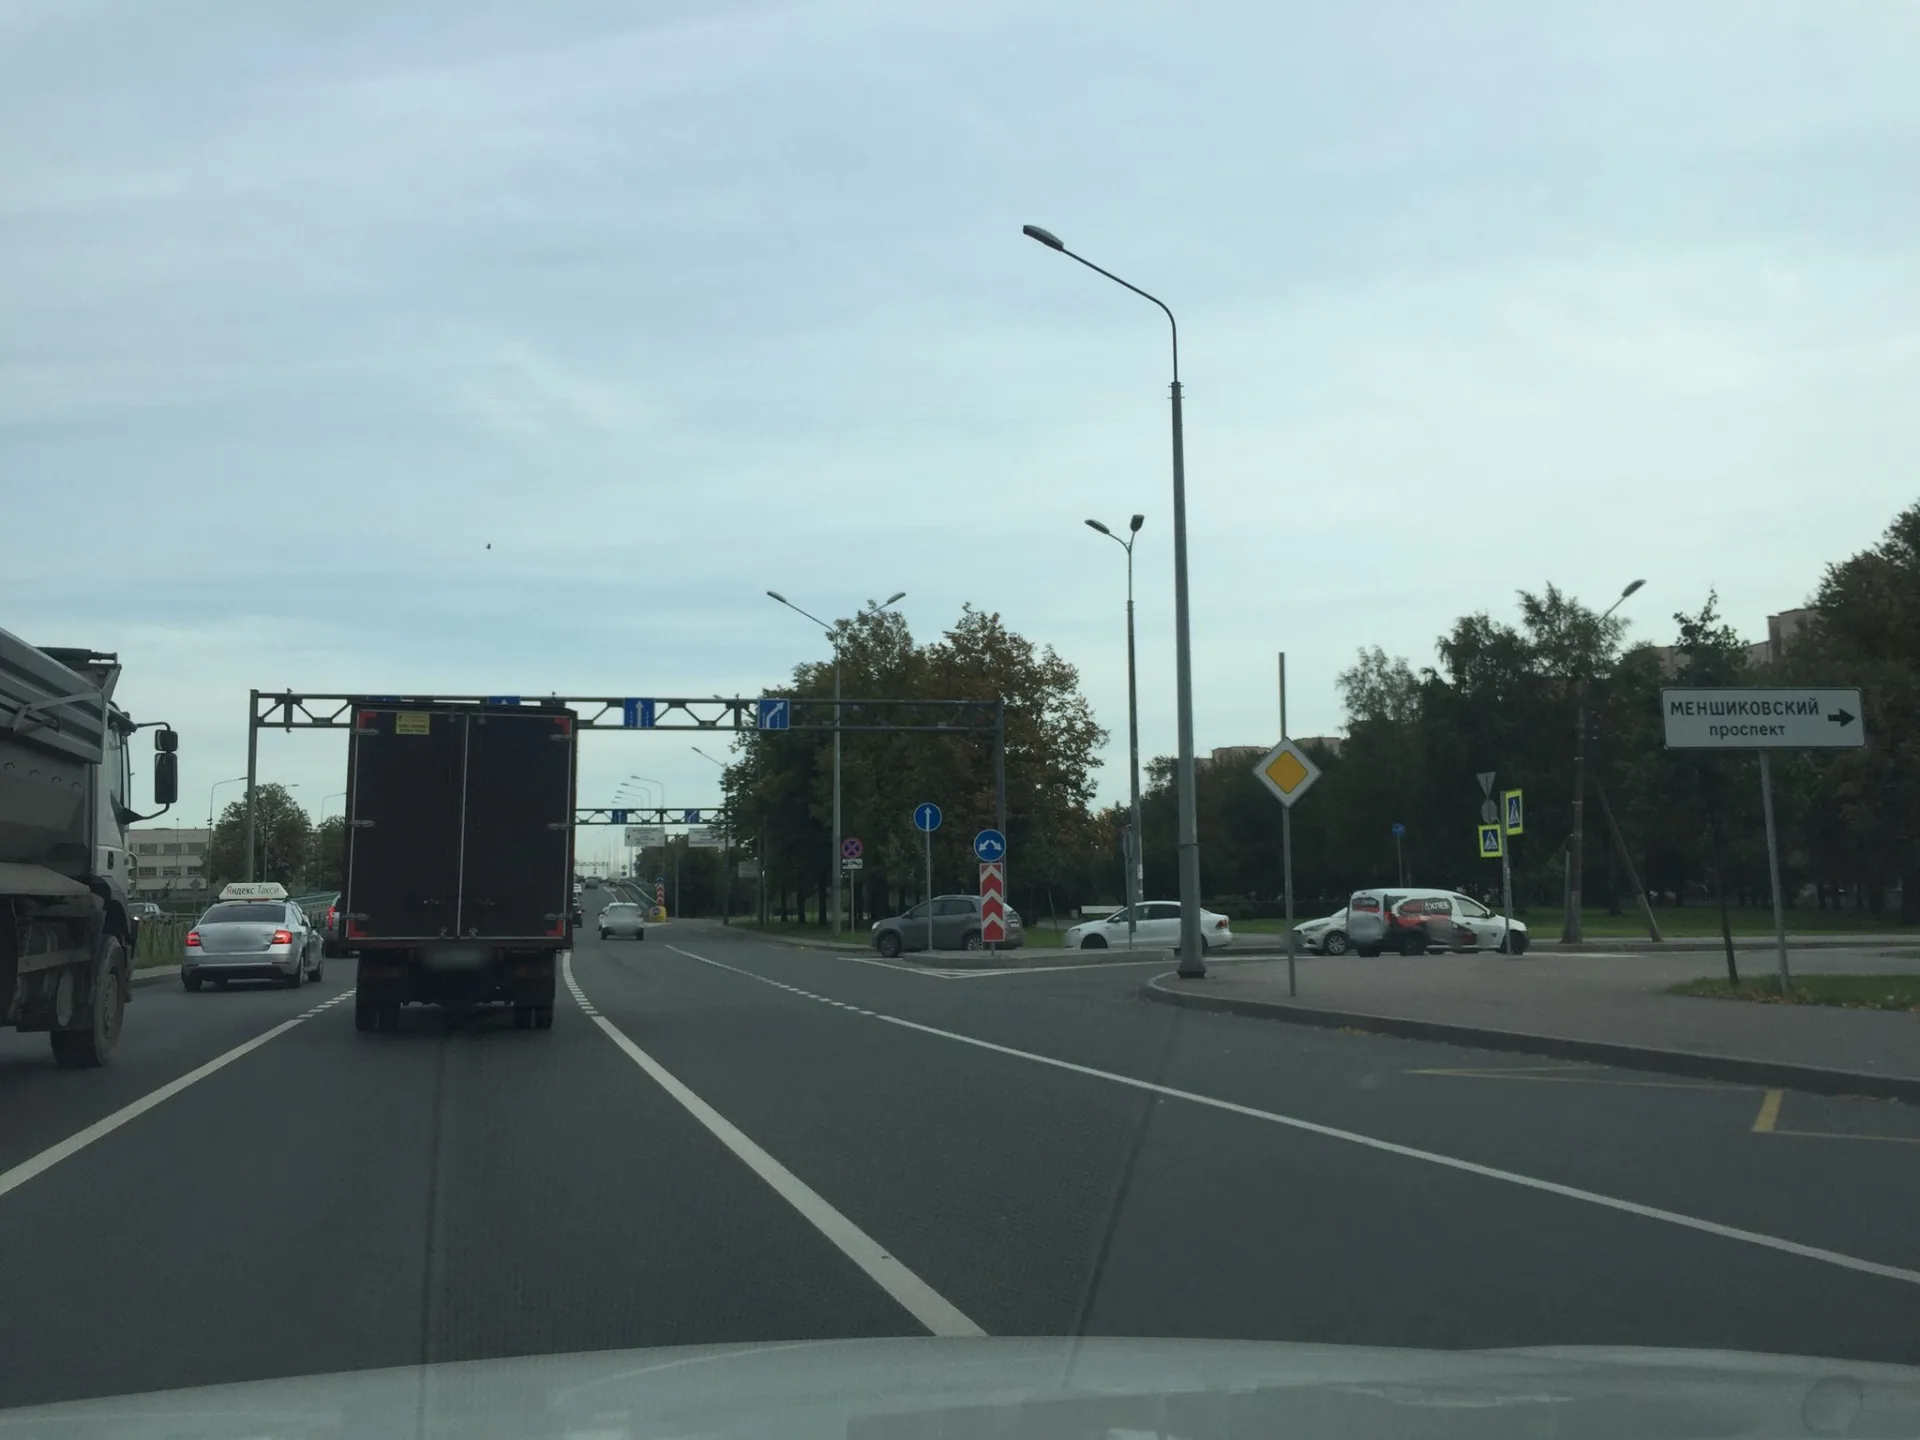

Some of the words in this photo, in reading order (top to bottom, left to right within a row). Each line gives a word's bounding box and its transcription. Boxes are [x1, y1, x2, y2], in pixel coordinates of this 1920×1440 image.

[1670, 697, 1819, 716] МЕНШИКОВСКИЙ
[1709, 725, 1785, 740] проспект
[226, 885, 255, 896] Яндекс
[258, 885, 280, 895] Такси
